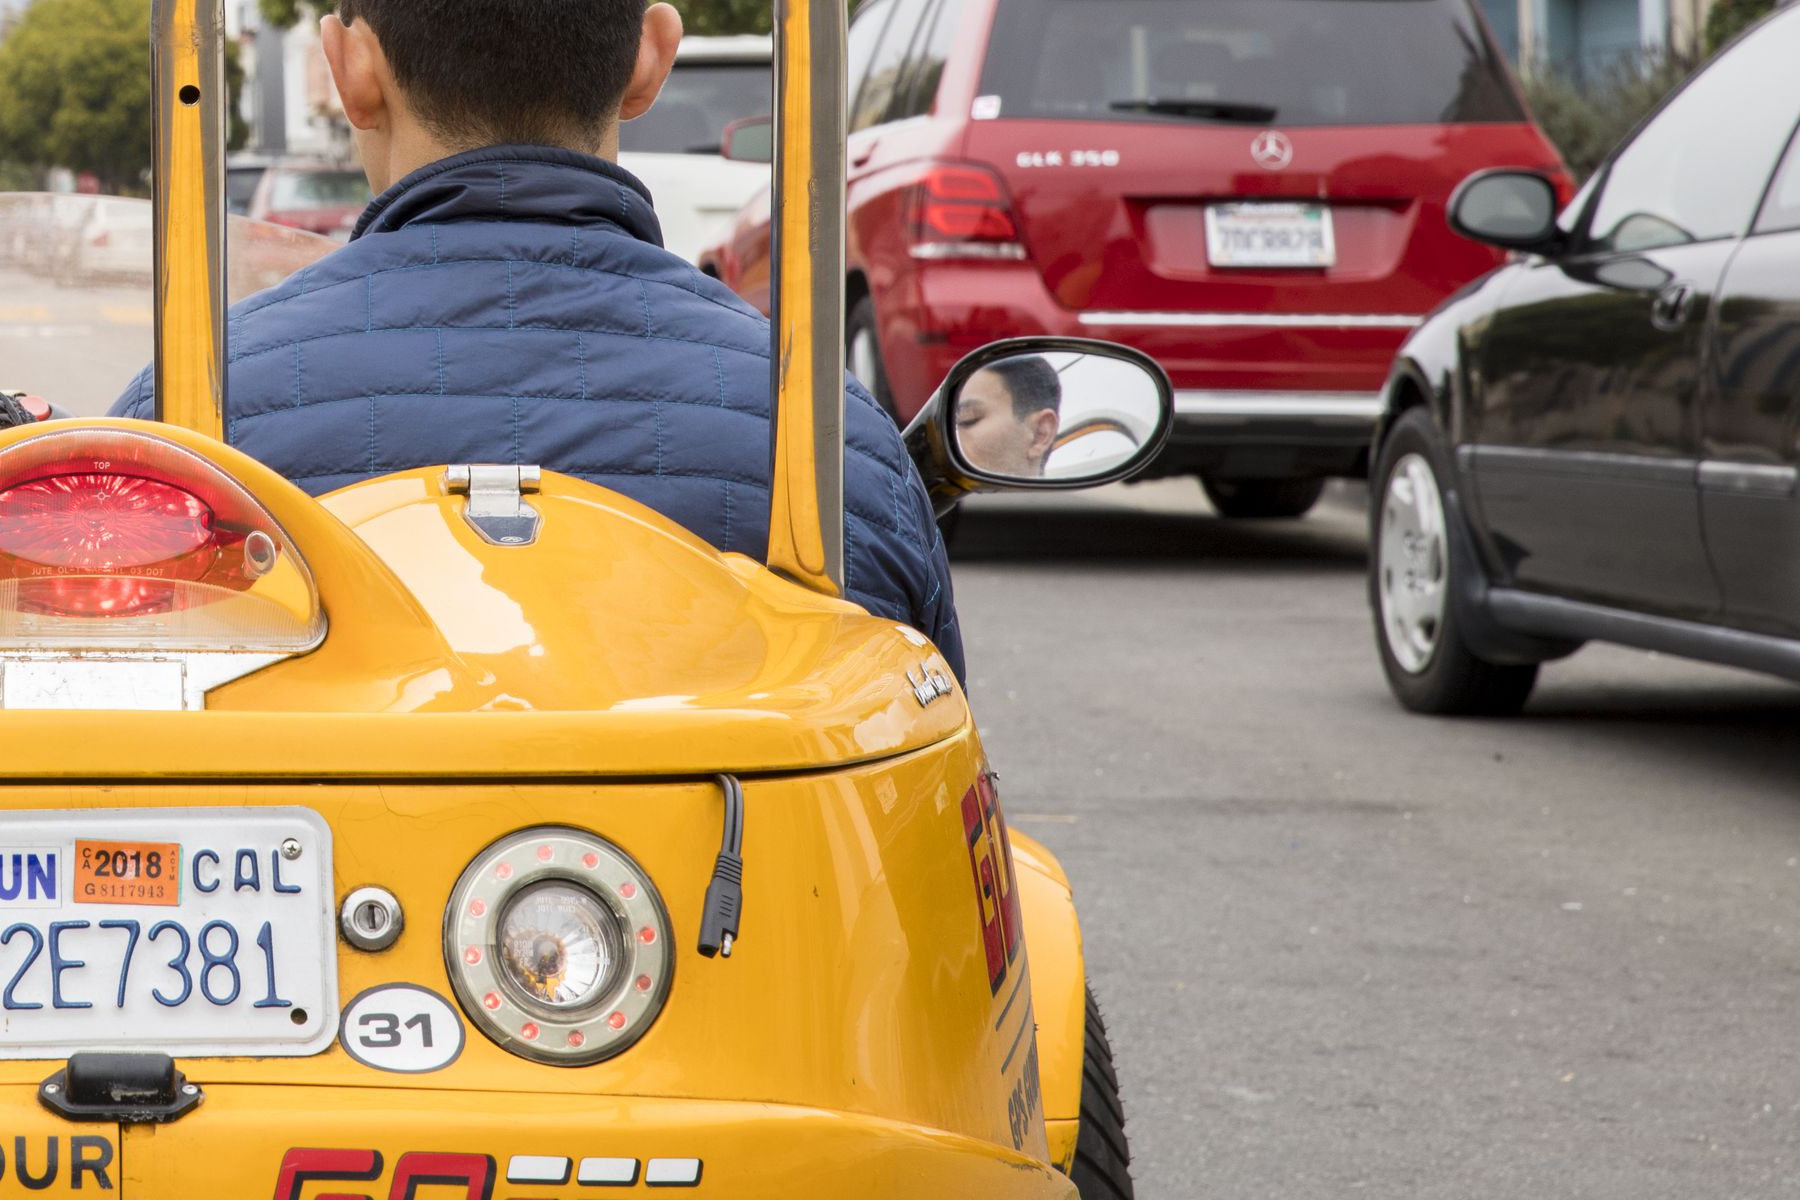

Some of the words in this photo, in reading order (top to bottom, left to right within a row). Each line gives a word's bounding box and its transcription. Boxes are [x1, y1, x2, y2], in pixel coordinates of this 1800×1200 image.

[93, 461, 111, 470] TOP
[31, 566, 53, 576] JUTE
[94, 849, 162, 879] 2018
[192, 848, 301, 893] CAL
[358, 1012, 434, 1048] 31
